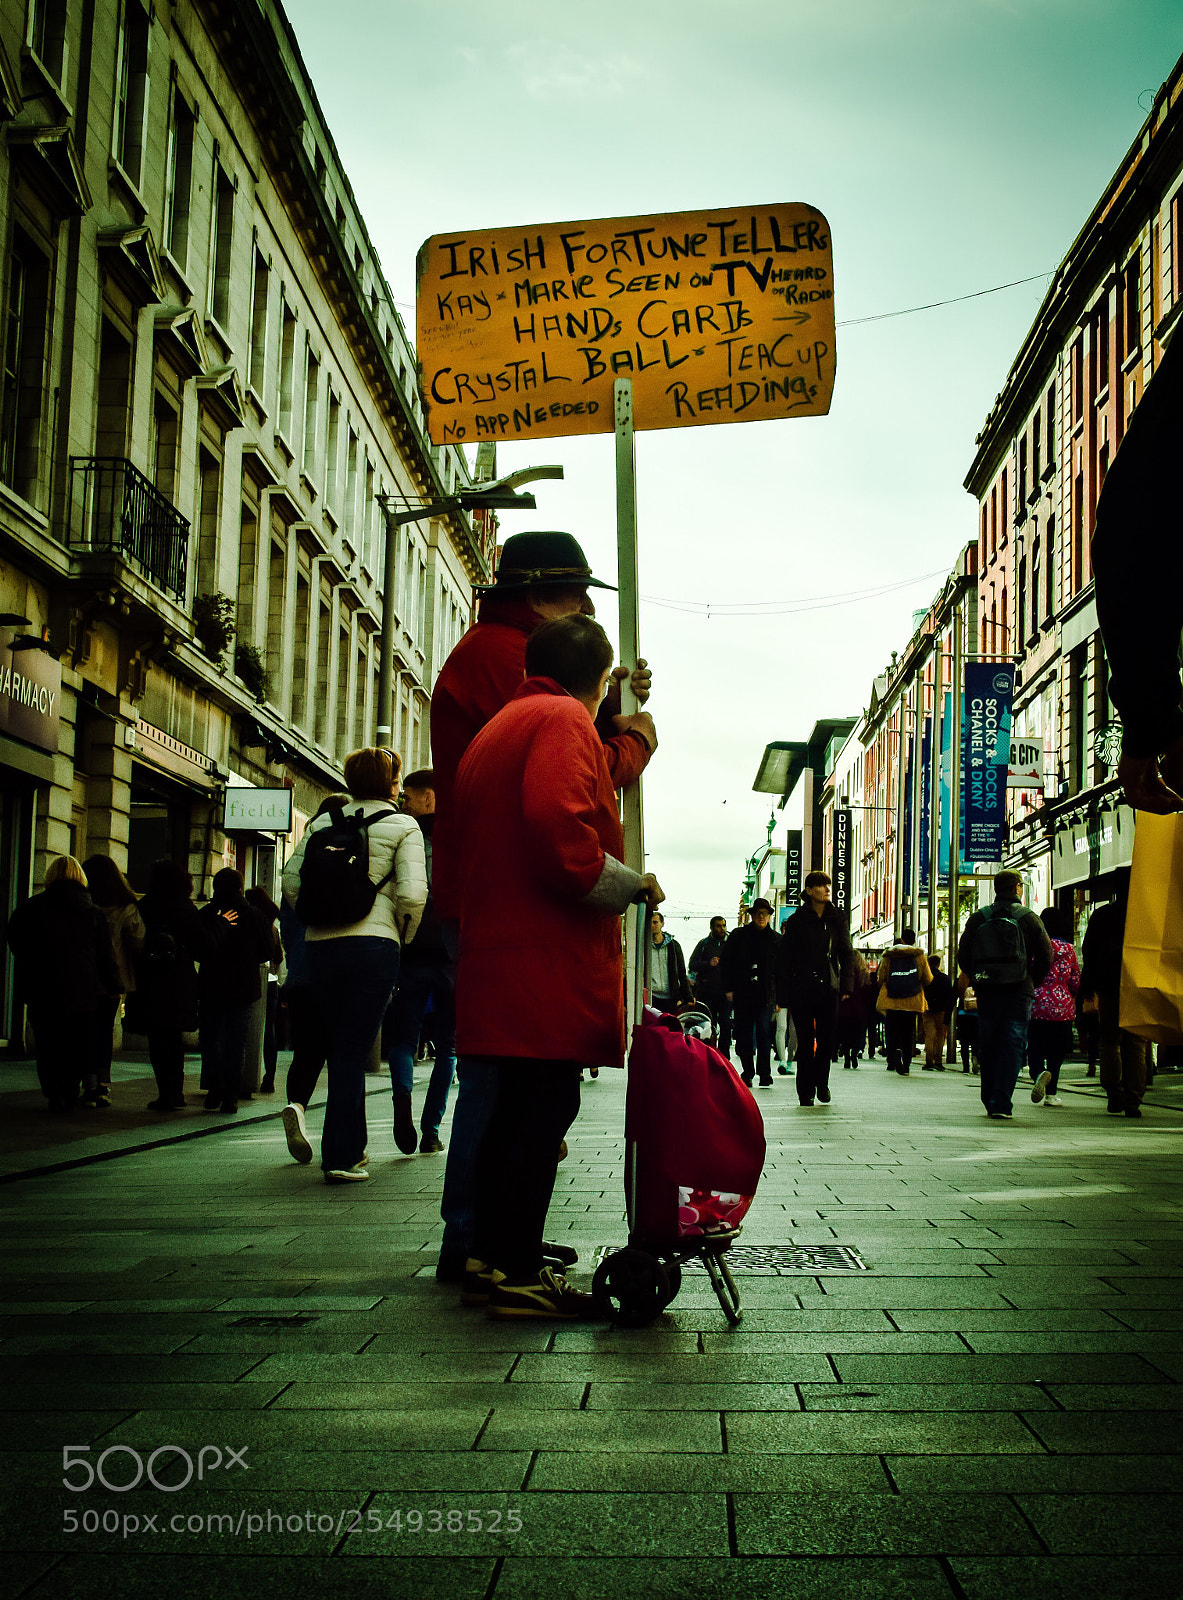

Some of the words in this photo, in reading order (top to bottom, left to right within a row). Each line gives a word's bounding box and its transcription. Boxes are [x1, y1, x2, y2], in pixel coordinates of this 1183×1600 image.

[436, 290, 492, 321] KAY
[605, 267, 681, 299] SEEN
[689, 272, 713, 289] ON
[711, 256, 773, 297] TV
[771, 266, 827, 283] HEARD
[576, 339, 690, 385] BALL
[971, 698, 983, 754] CHANEL
[985, 698, 998, 746] SOCKS
[971, 757, 983, 768] &
[985, 748, 998, 759] &
[1018, 743, 1040, 766] CITY
[229, 799, 286, 818] fields
[971, 771, 983, 810] DKNY
[837, 814, 847, 867] DUNNES
[836, 871, 846, 911] STOR
